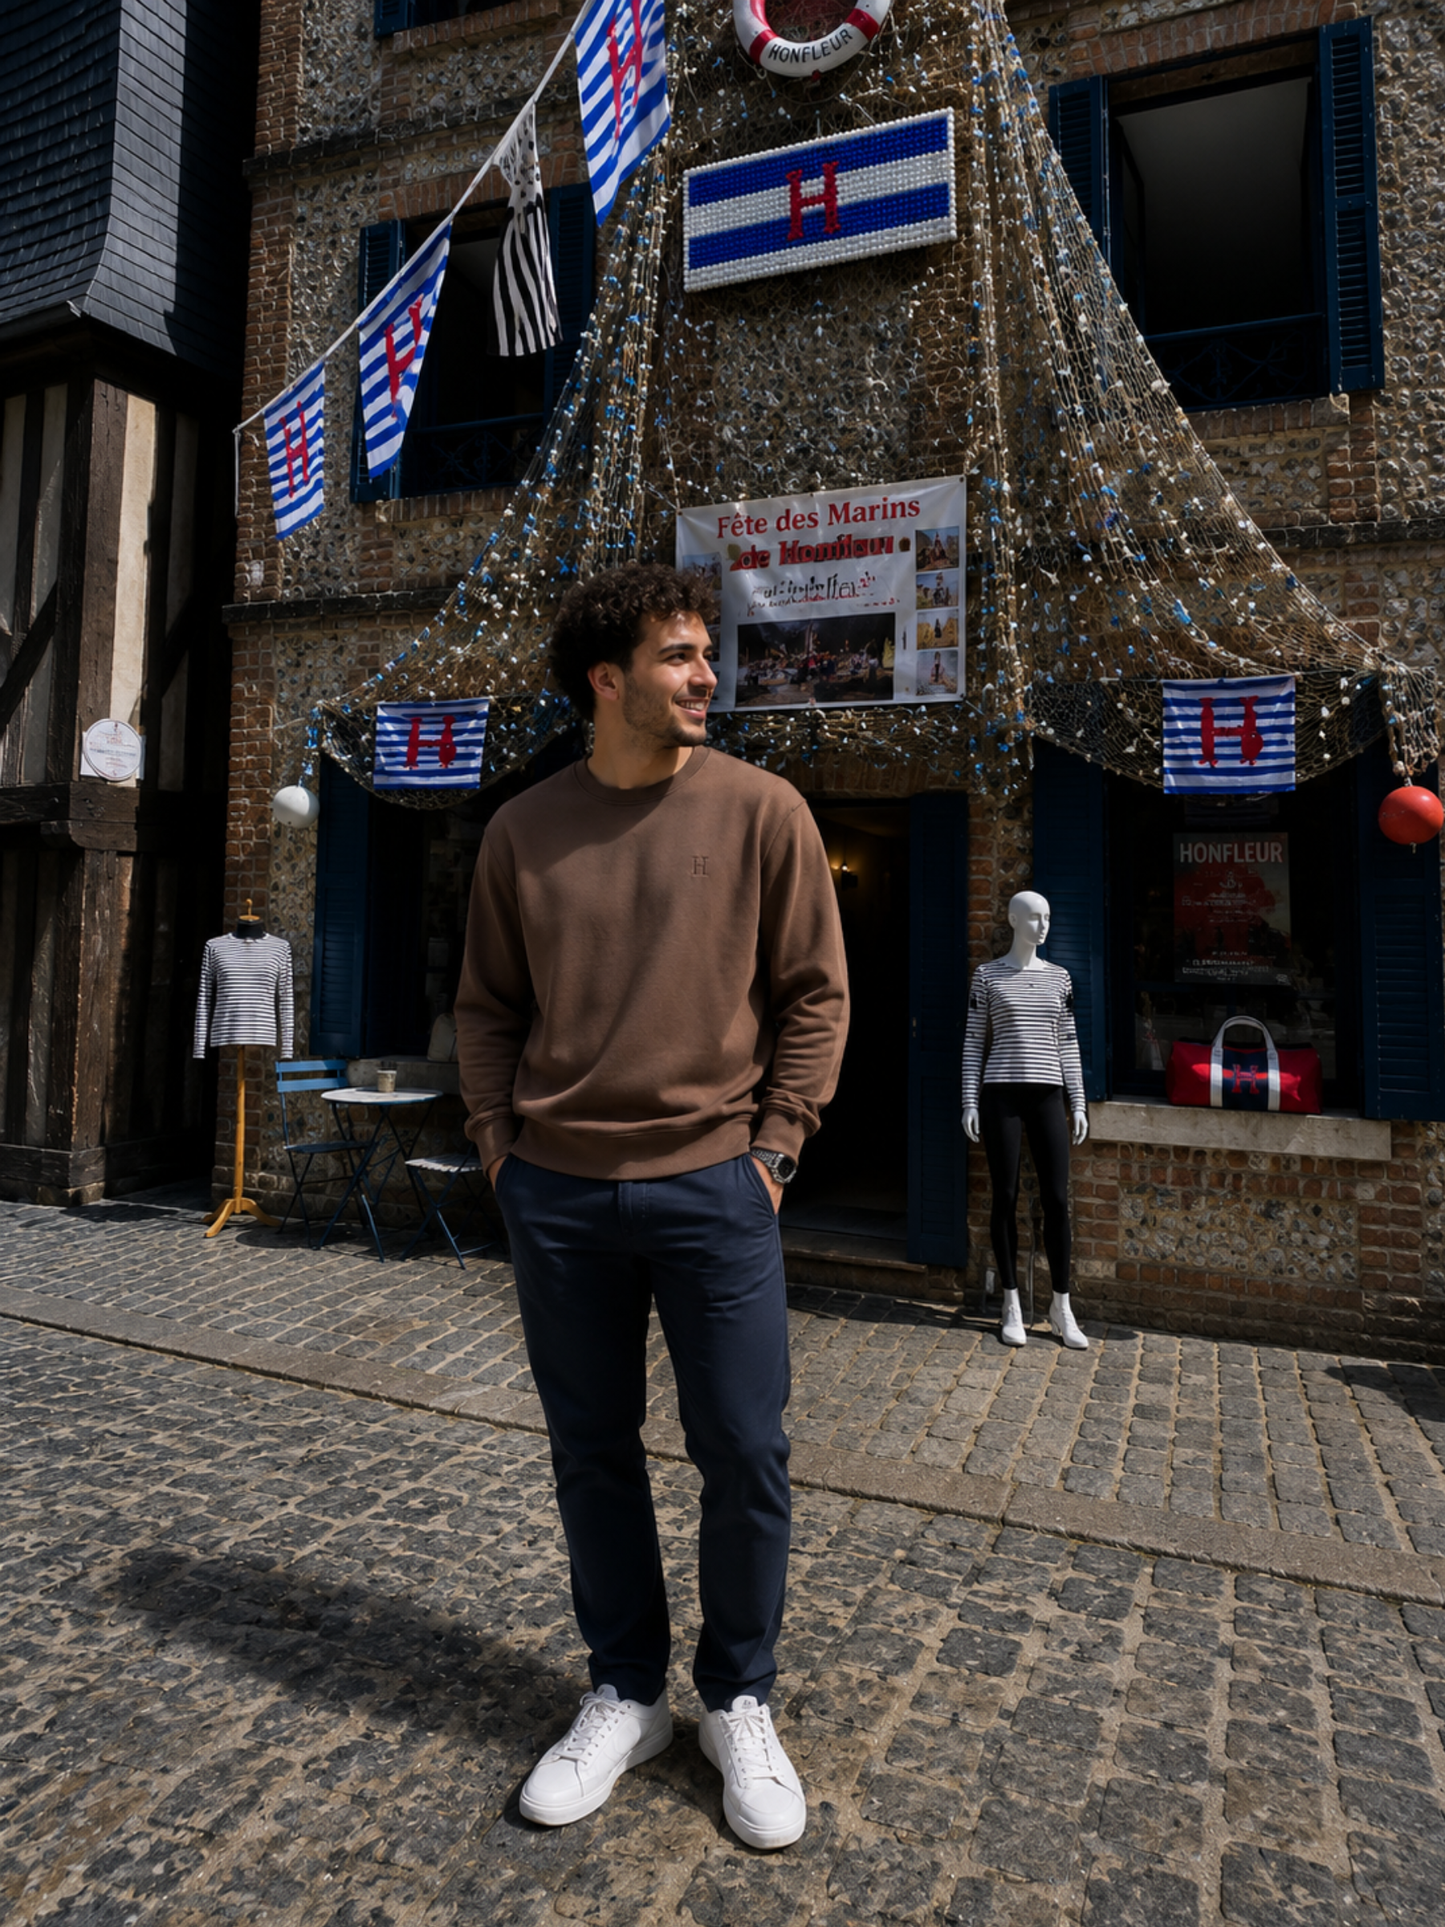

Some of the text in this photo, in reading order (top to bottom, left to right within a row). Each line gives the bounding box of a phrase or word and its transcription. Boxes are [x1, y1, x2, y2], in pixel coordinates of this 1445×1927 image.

[768, 29, 853, 63] HONFLEUR
[786, 161, 841, 241] H
[279, 401, 310, 498] H
[717, 496, 921, 539] Fête des Marins
[734, 544, 770, 570] de
[404, 714, 457, 769] H
[1198, 696, 1264, 767] H
[691, 856, 709, 878] H
[1179, 842, 1283, 864] HONFLEUR
[1231, 1063, 1260, 1095] H
